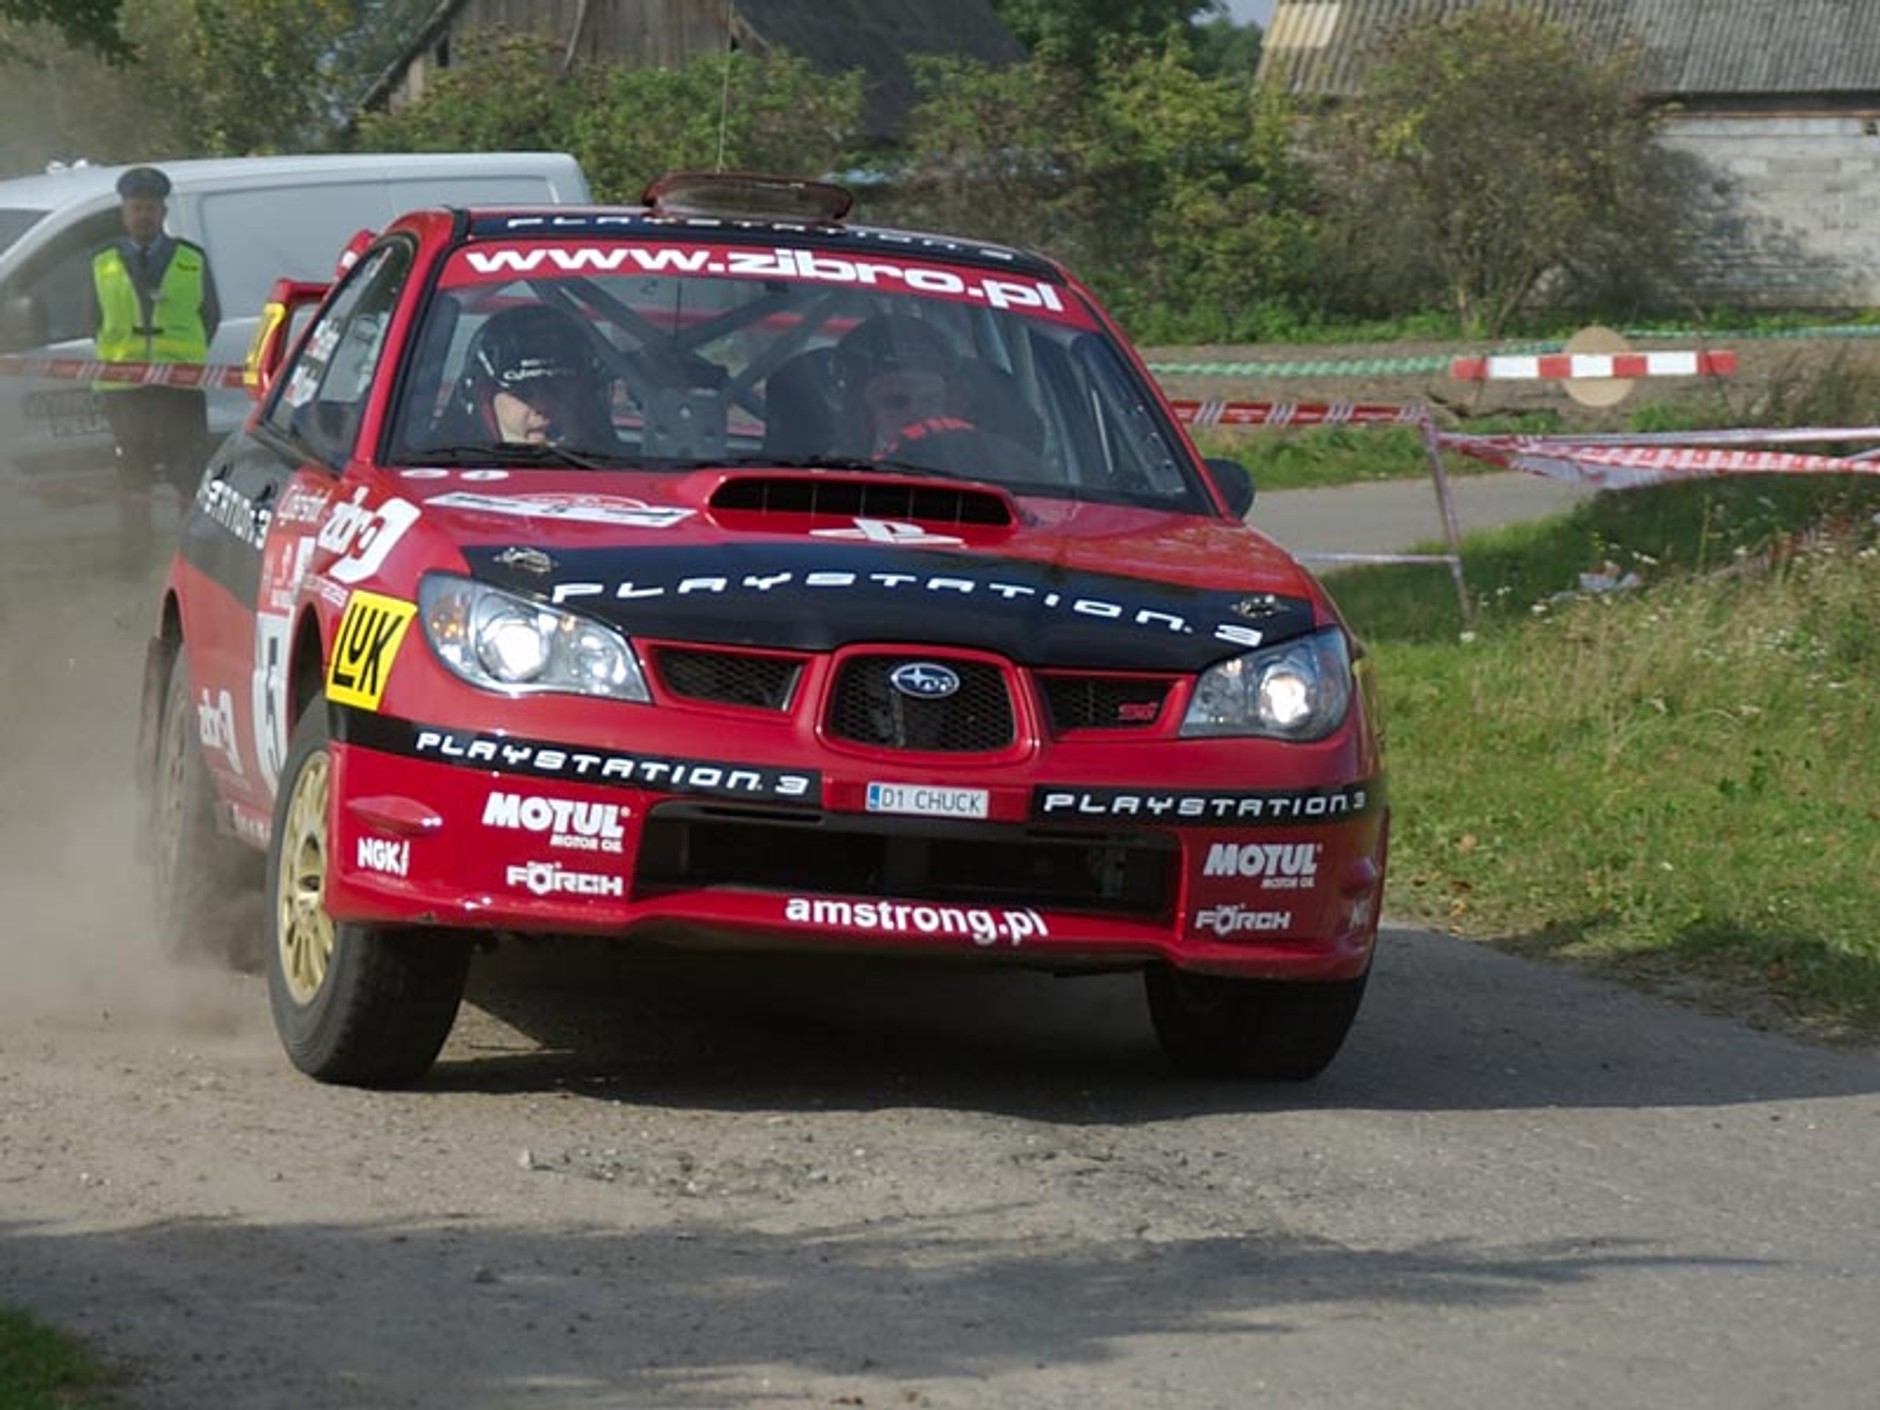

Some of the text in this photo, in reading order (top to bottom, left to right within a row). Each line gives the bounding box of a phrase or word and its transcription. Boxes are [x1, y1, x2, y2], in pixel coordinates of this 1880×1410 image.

[466, 241, 1063, 312] www.zibro.pl
[482, 791, 625, 838] MOTUL
[882, 787, 982, 814] D1 CHUCK
[1043, 791, 1347, 817] PLAYSTATION
[1203, 843, 1318, 876] MOTUL
[784, 898, 1048, 946] amstrong.pl
